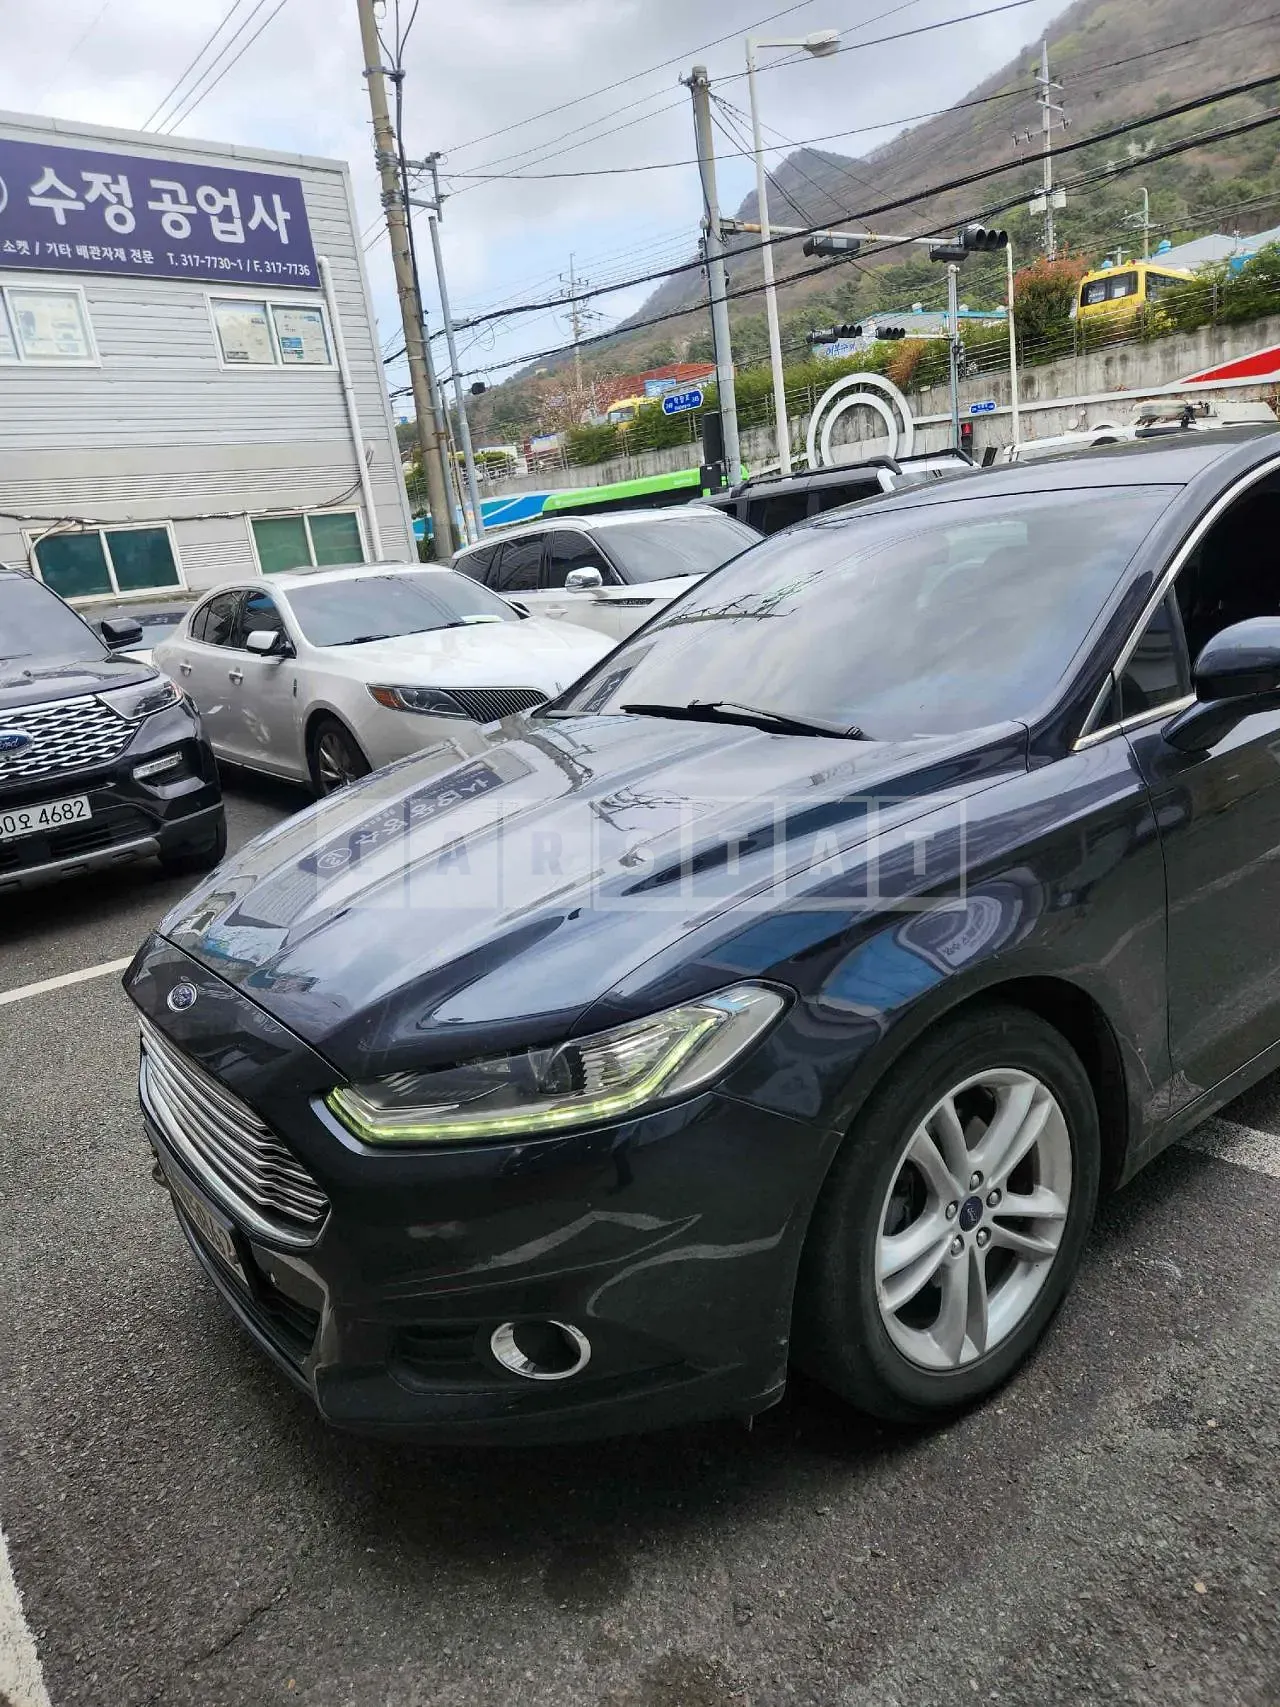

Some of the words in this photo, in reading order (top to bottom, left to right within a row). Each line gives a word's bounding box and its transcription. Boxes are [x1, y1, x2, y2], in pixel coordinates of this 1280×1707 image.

[28, 166, 136, 234] 수정
[148, 179, 291, 244] 공업사
[3, 239, 31, 256] 소켓
[35, 241, 40, 256] /
[45, 242, 72, 258] 기타
[75, 245, 127, 261] 배관자재
[130, 249, 154, 264] 전문
[166, 252, 178, 266] T.
[180, 254, 243, 271] 317-7730~1
[253, 260, 263, 273] F.
[264, 261, 311, 276] 317-7736
[0, 813, 33, 836] 0오
[39, 800, 87, 825] 4682
